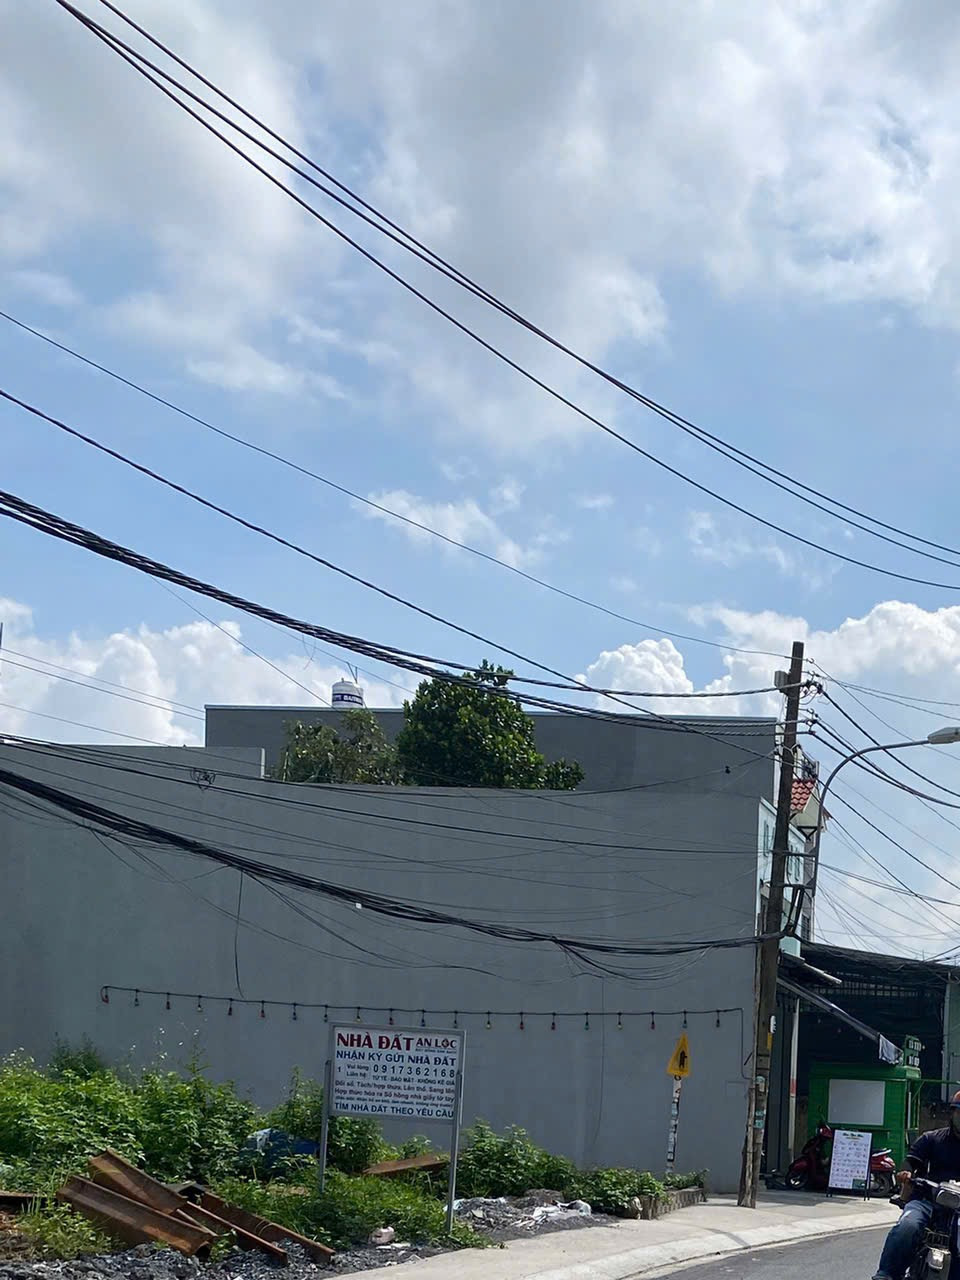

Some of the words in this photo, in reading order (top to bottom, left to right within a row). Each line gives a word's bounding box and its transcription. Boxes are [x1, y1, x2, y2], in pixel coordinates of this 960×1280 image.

[337, 1032, 373, 1049] NHÀ
[378, 1033, 414, 1051] ĐẤT
[416, 1037, 432, 1047] AN
[336, 1050, 366, 1061] NHẬN
[368, 1050, 383, 1061] KÝ
[408, 1054, 430, 1065] NHÀ
[434, 1055, 457, 1067] ĐẤT
[335, 1101, 349, 1110] TÌM
[351, 1103, 369, 1113] NHÀ
[391, 1105, 414, 1115] THEO
[416, 1107, 433, 1117] YÊU
[436, 1108, 455, 1118] CẦU
